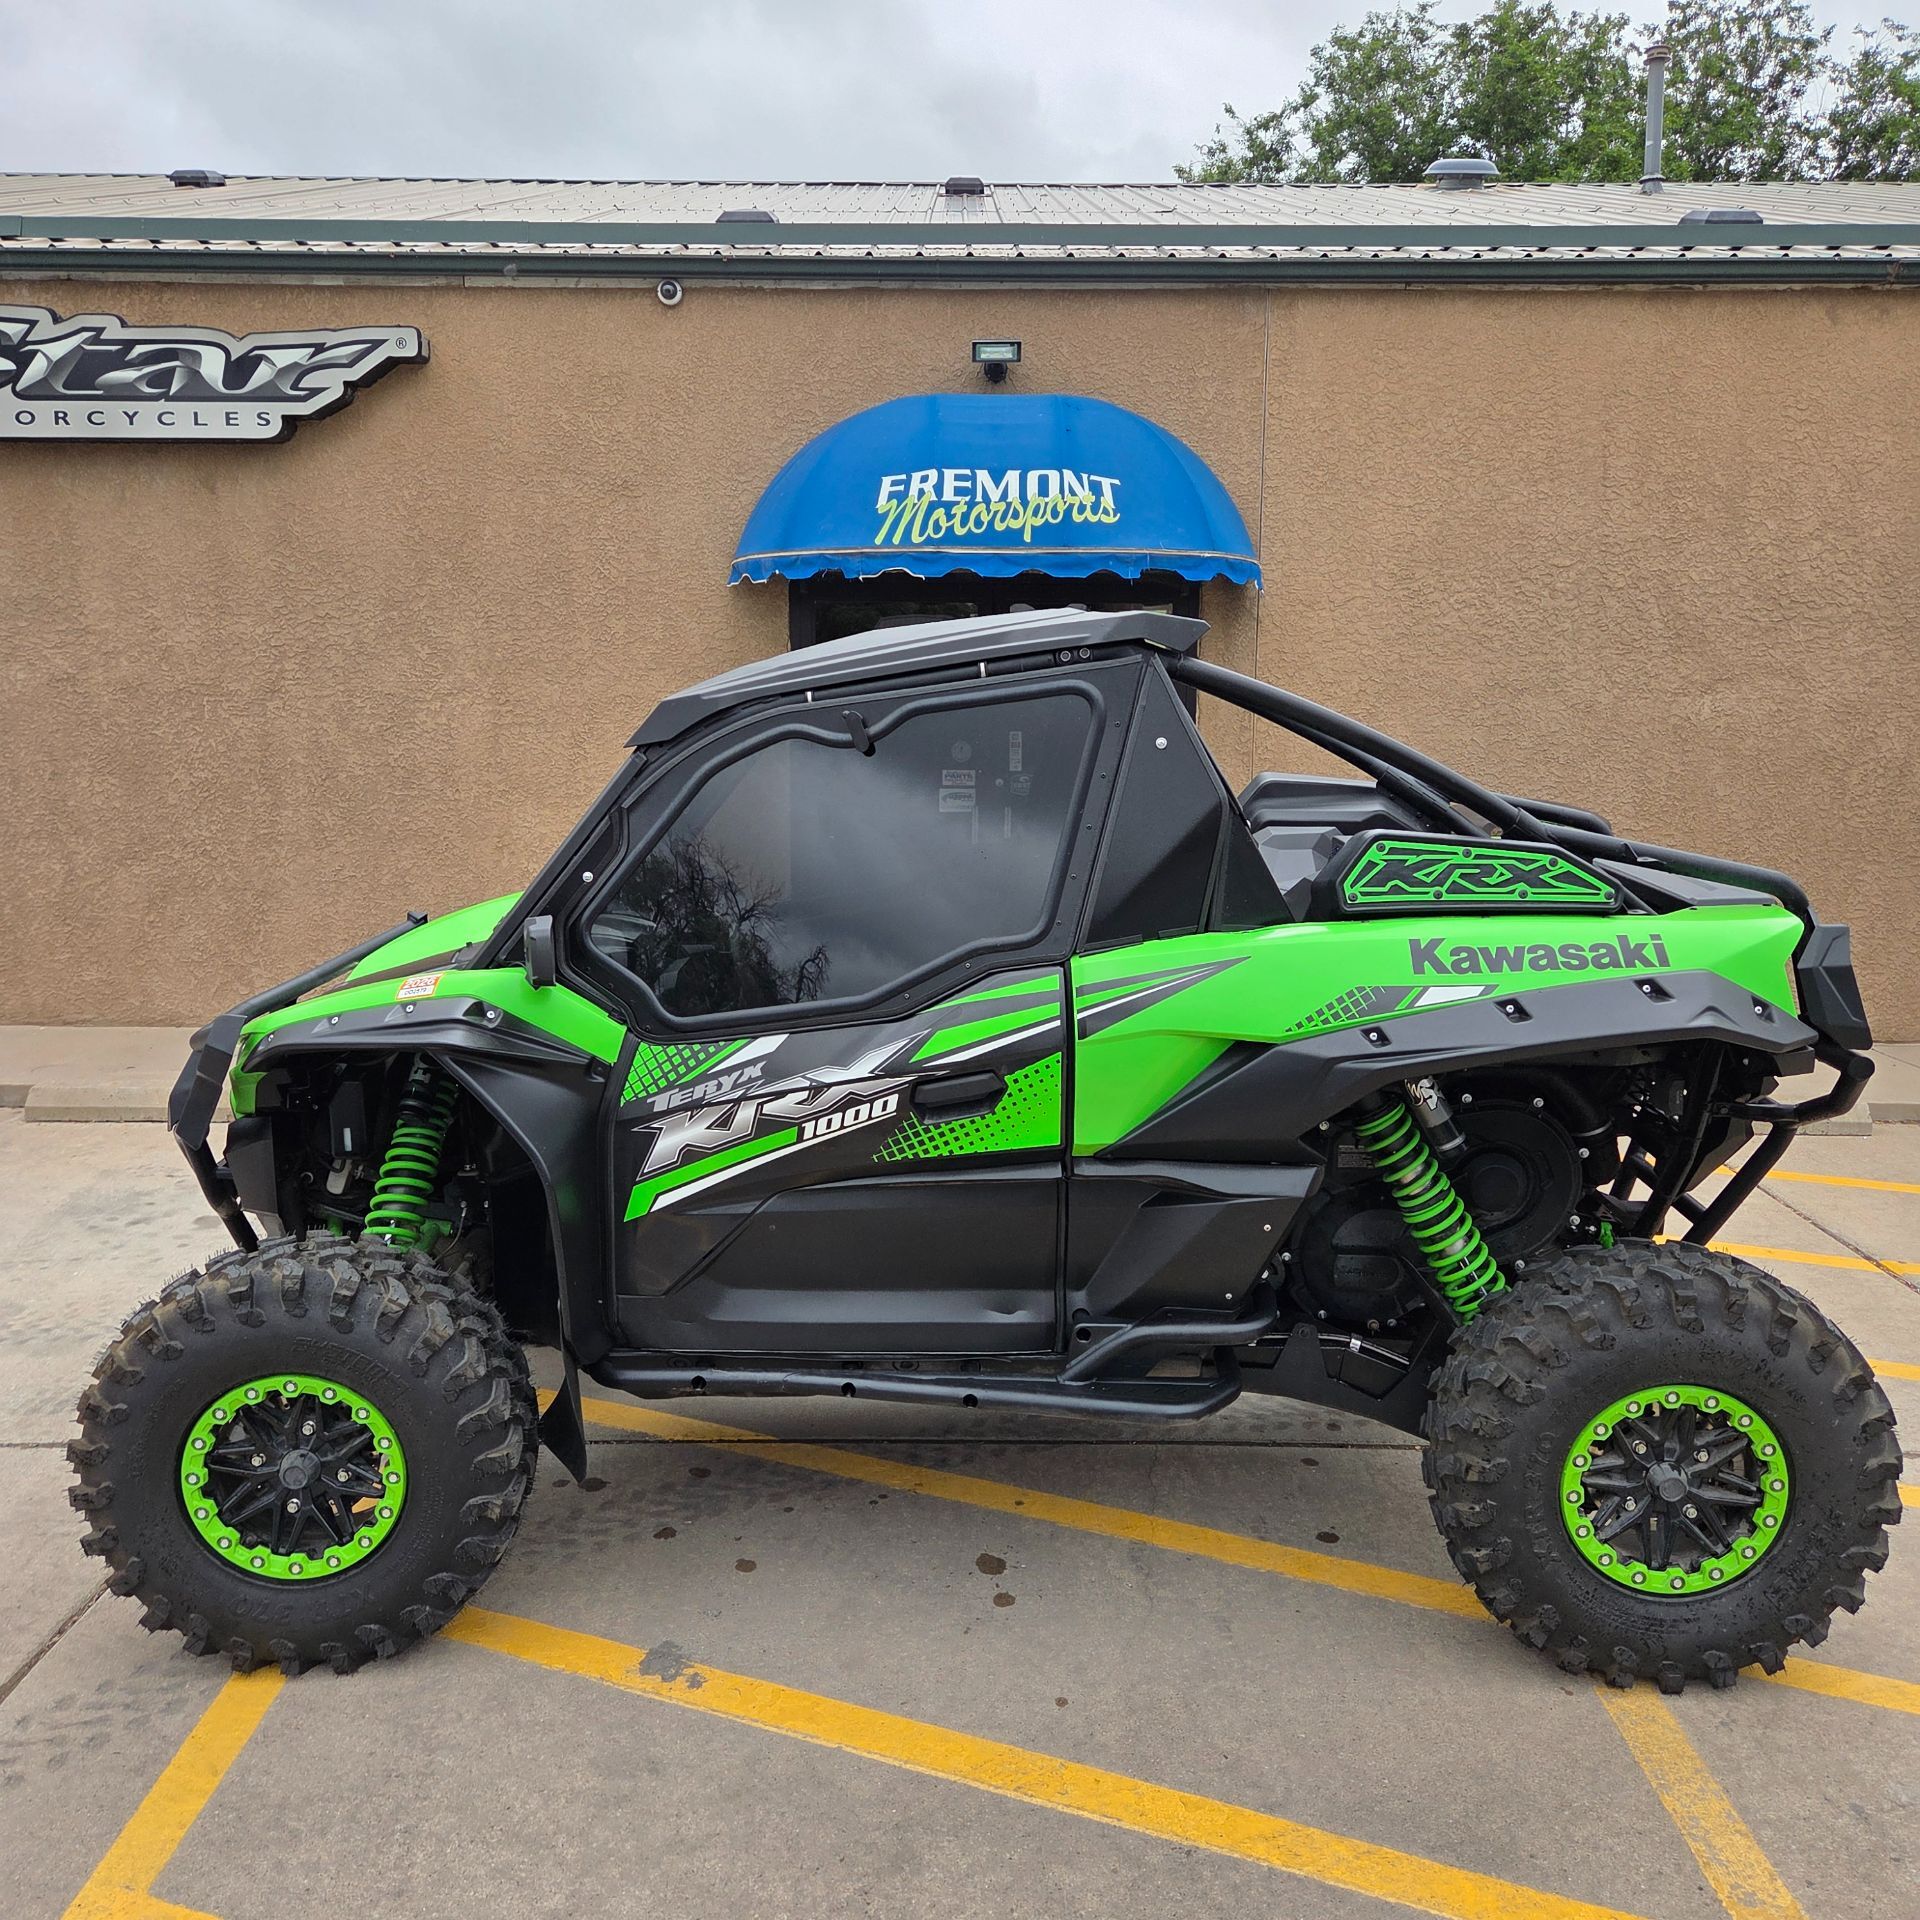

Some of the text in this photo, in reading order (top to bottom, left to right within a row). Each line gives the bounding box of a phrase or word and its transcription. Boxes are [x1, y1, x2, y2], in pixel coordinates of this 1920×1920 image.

[875, 468, 1122, 509] FREMONT
[874, 490, 1121, 545] Motorsports
[1354, 855, 1598, 894] KRX
[1408, 933, 1672, 976] Kawasaki
[632, 1029, 931, 1181] KRX
[646, 1060, 768, 1113] TERYX
[802, 1093, 899, 1140] 1000
